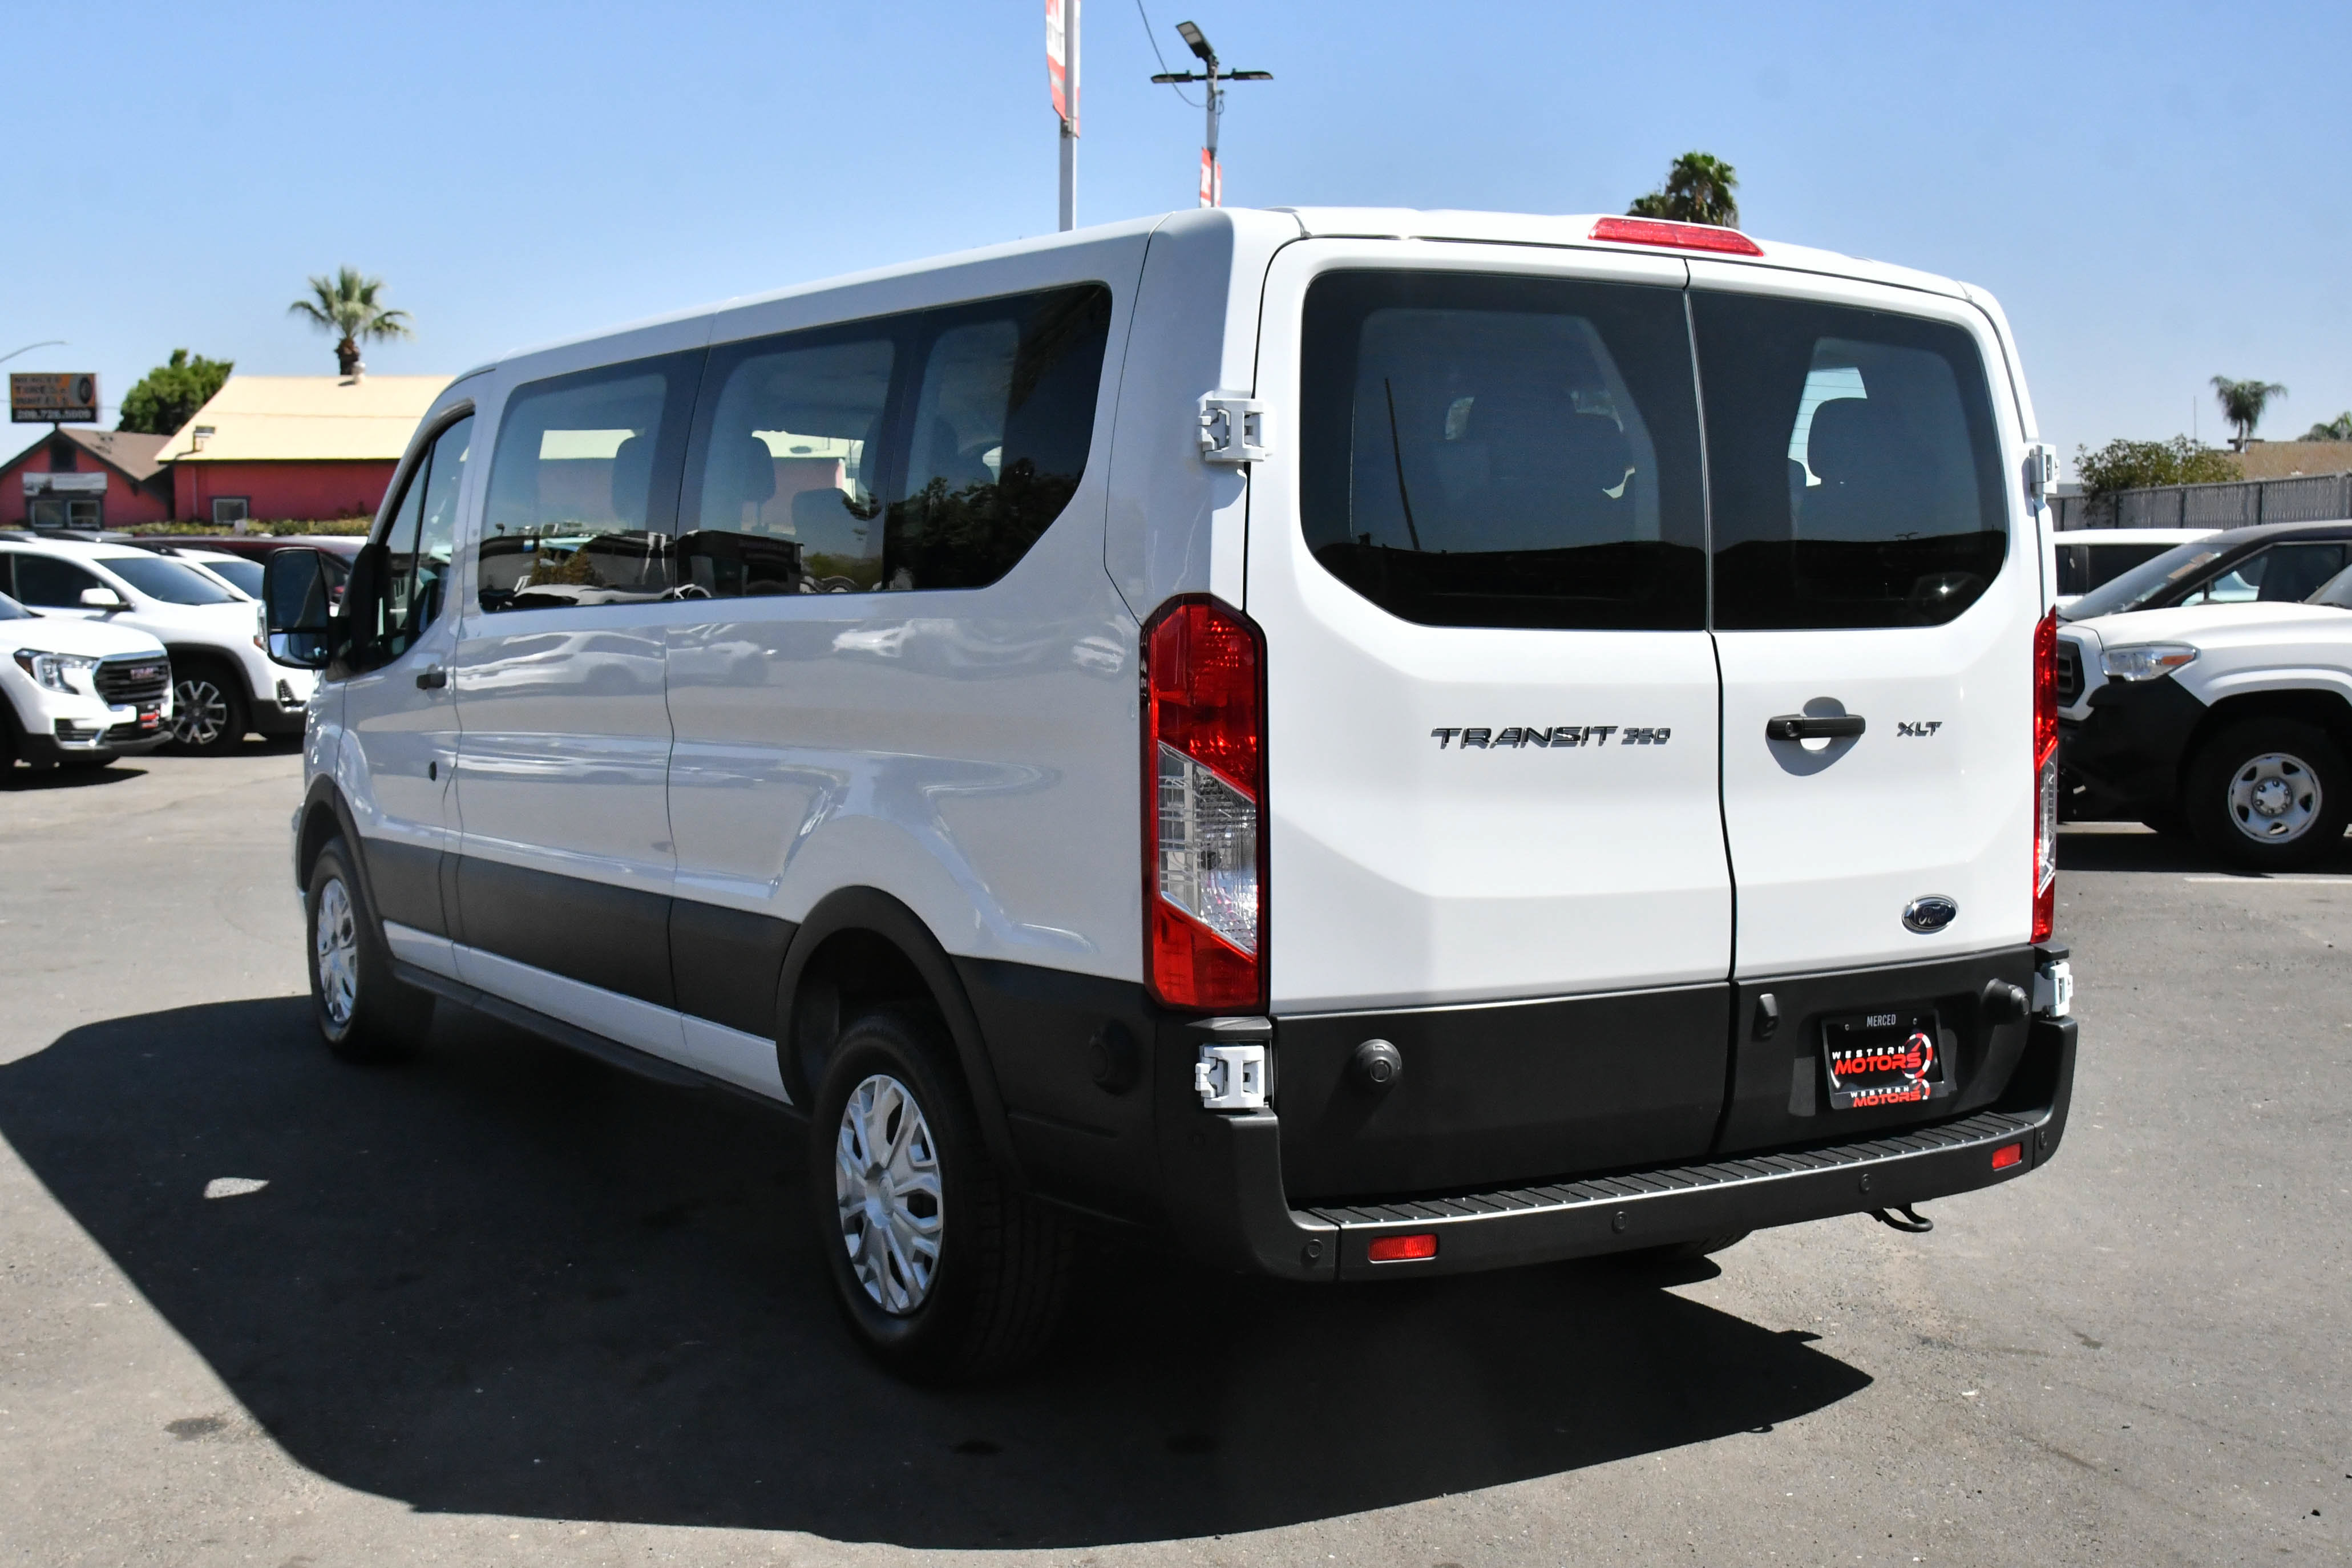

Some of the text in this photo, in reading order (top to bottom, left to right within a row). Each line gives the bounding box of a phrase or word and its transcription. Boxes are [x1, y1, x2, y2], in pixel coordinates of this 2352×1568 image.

[1897, 721, 1942, 736] XLT
[1431, 726, 1671, 747] TRANSIT 350
[1866, 1014, 1896, 1027] MERCED
[1832, 1046, 1905, 1060] WESTERN
[1834, 1052, 1922, 1075] MOTORS
[1850, 1086, 1909, 1098] WESTERN
[1853, 1090, 1921, 1108] MOTORS
